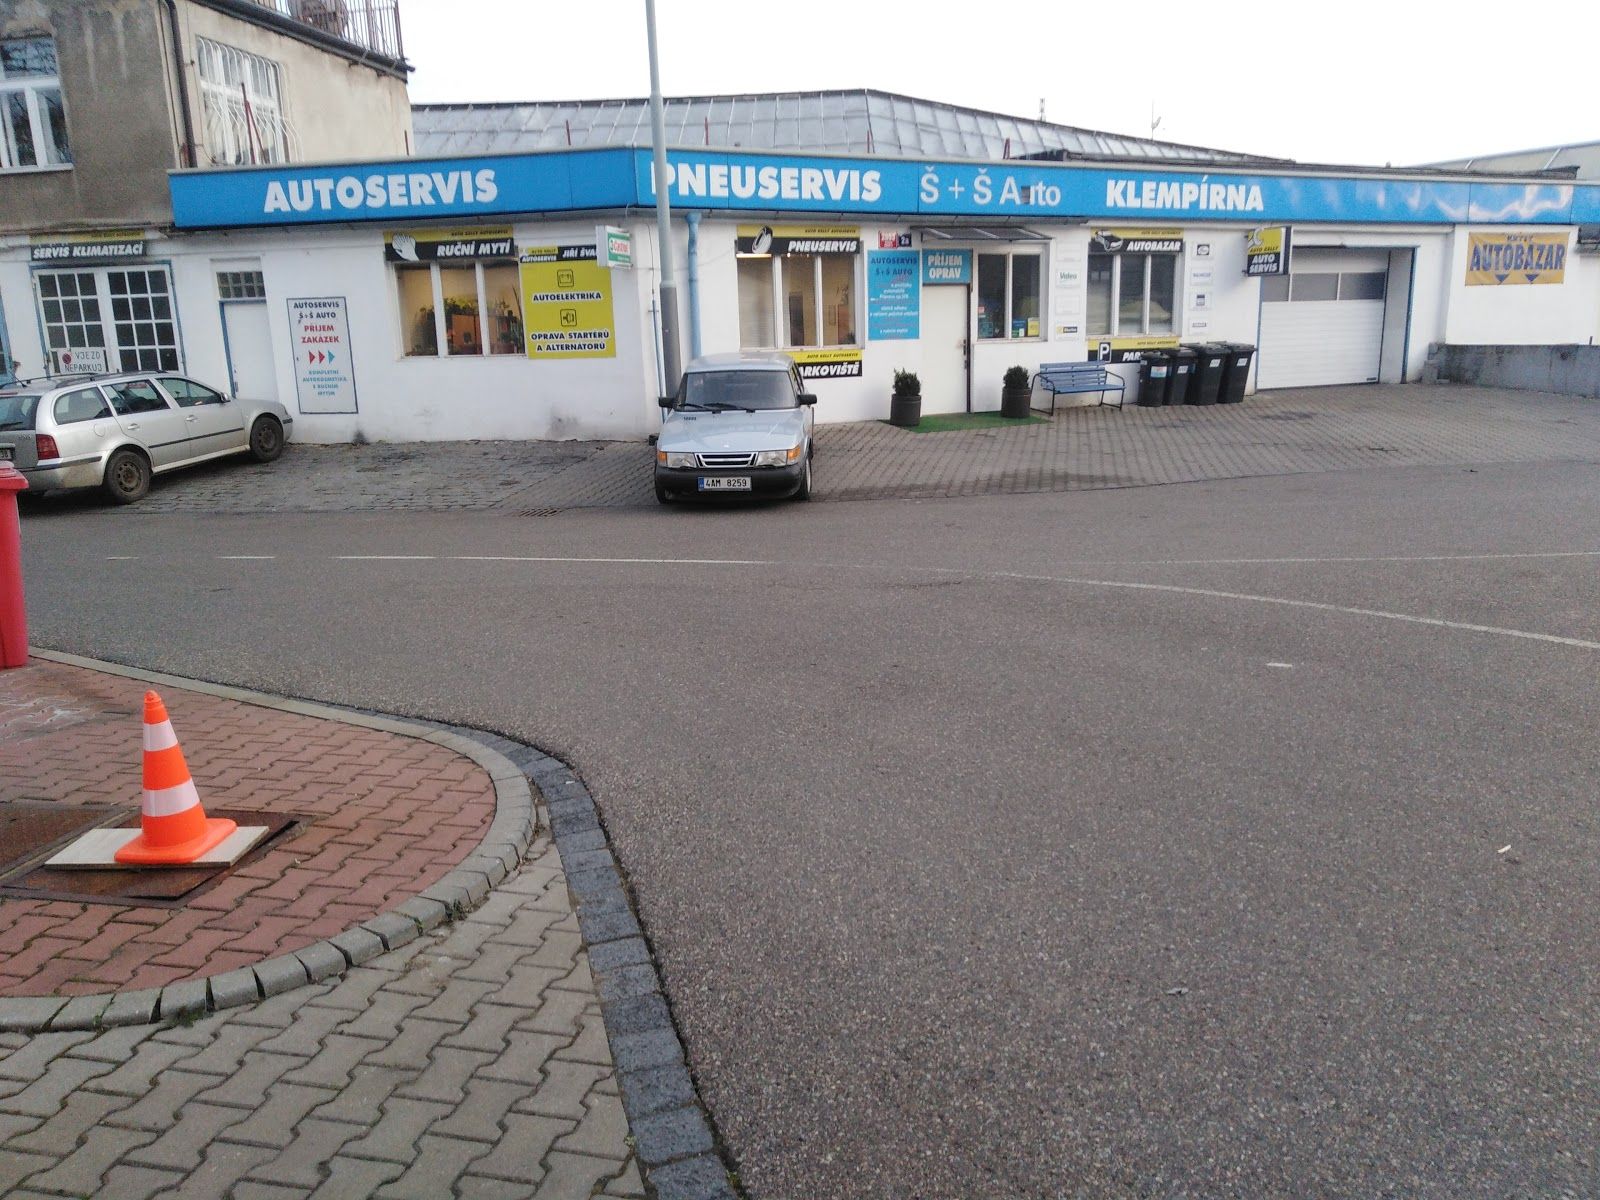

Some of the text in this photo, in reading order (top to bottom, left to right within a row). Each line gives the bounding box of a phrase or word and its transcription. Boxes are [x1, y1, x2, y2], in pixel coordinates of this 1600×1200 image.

[650, 161, 882, 202] PNEUSERVIS
[264, 169, 497, 213] AUTOSERVIS
[1106, 174, 1264, 212] KLEMPÍRNA
[437, 239, 511, 257] RUČNÍ MYTÍ
[580, 246, 598, 257] ŠVA
[788, 240, 857, 253] PNEUSERVIS
[1126, 240, 1181, 251] AUTOBAZAR
[33, 246, 70, 259] SERVIS
[1469, 244, 1566, 271] AUTOBAZAR
[1252, 254, 1275, 264] AUTO
[929, 267, 962, 280] OPRAV
[1249, 262, 1278, 274] SERVIS
[533, 292, 602, 301] AUTOELEKTRIKA
[293, 300, 340, 309] AUTOSERVIS
[316, 311, 336, 319] AUTO
[531, 332, 565, 341] OPRAVA
[1100, 343, 1109, 360] P
[705, 478, 747, 488] 4AM 8259
